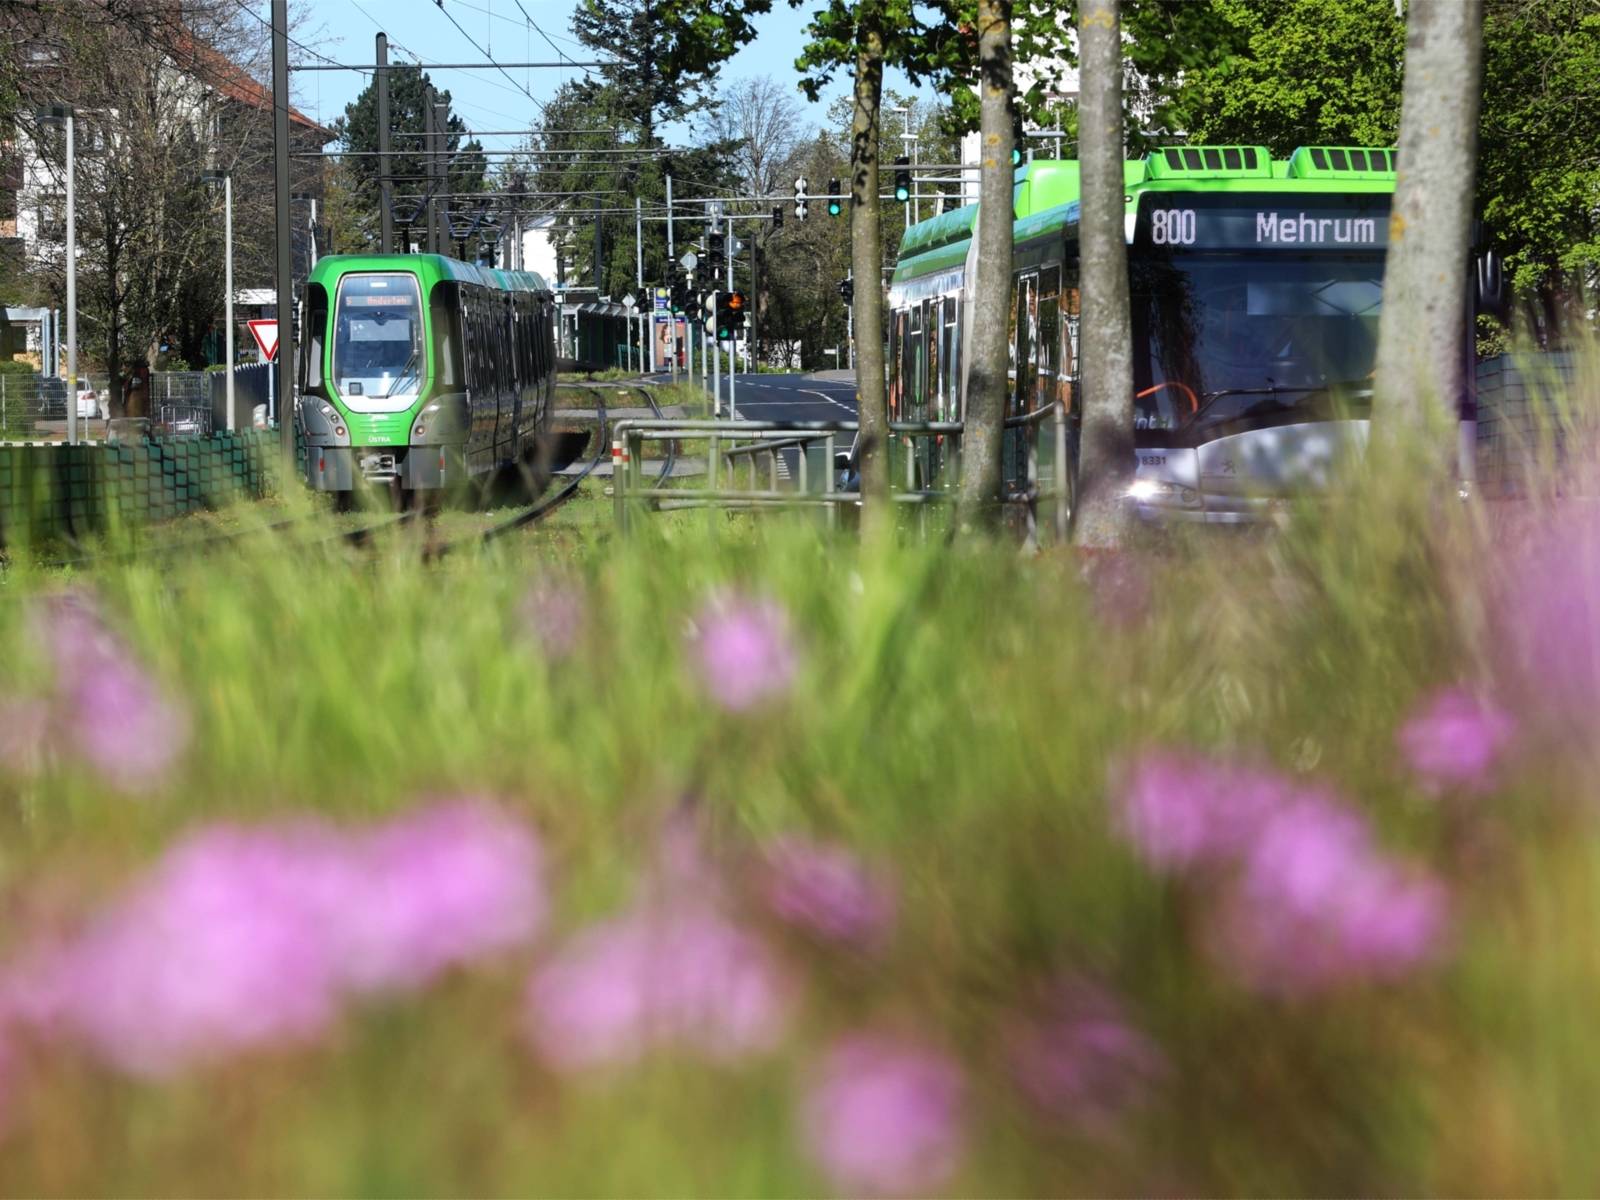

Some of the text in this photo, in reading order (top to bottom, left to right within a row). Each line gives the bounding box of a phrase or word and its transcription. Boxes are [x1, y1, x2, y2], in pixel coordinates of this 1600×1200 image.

[1152, 209, 1375, 244] 800 Mehrum
[1142, 456, 1167, 466] 8331
